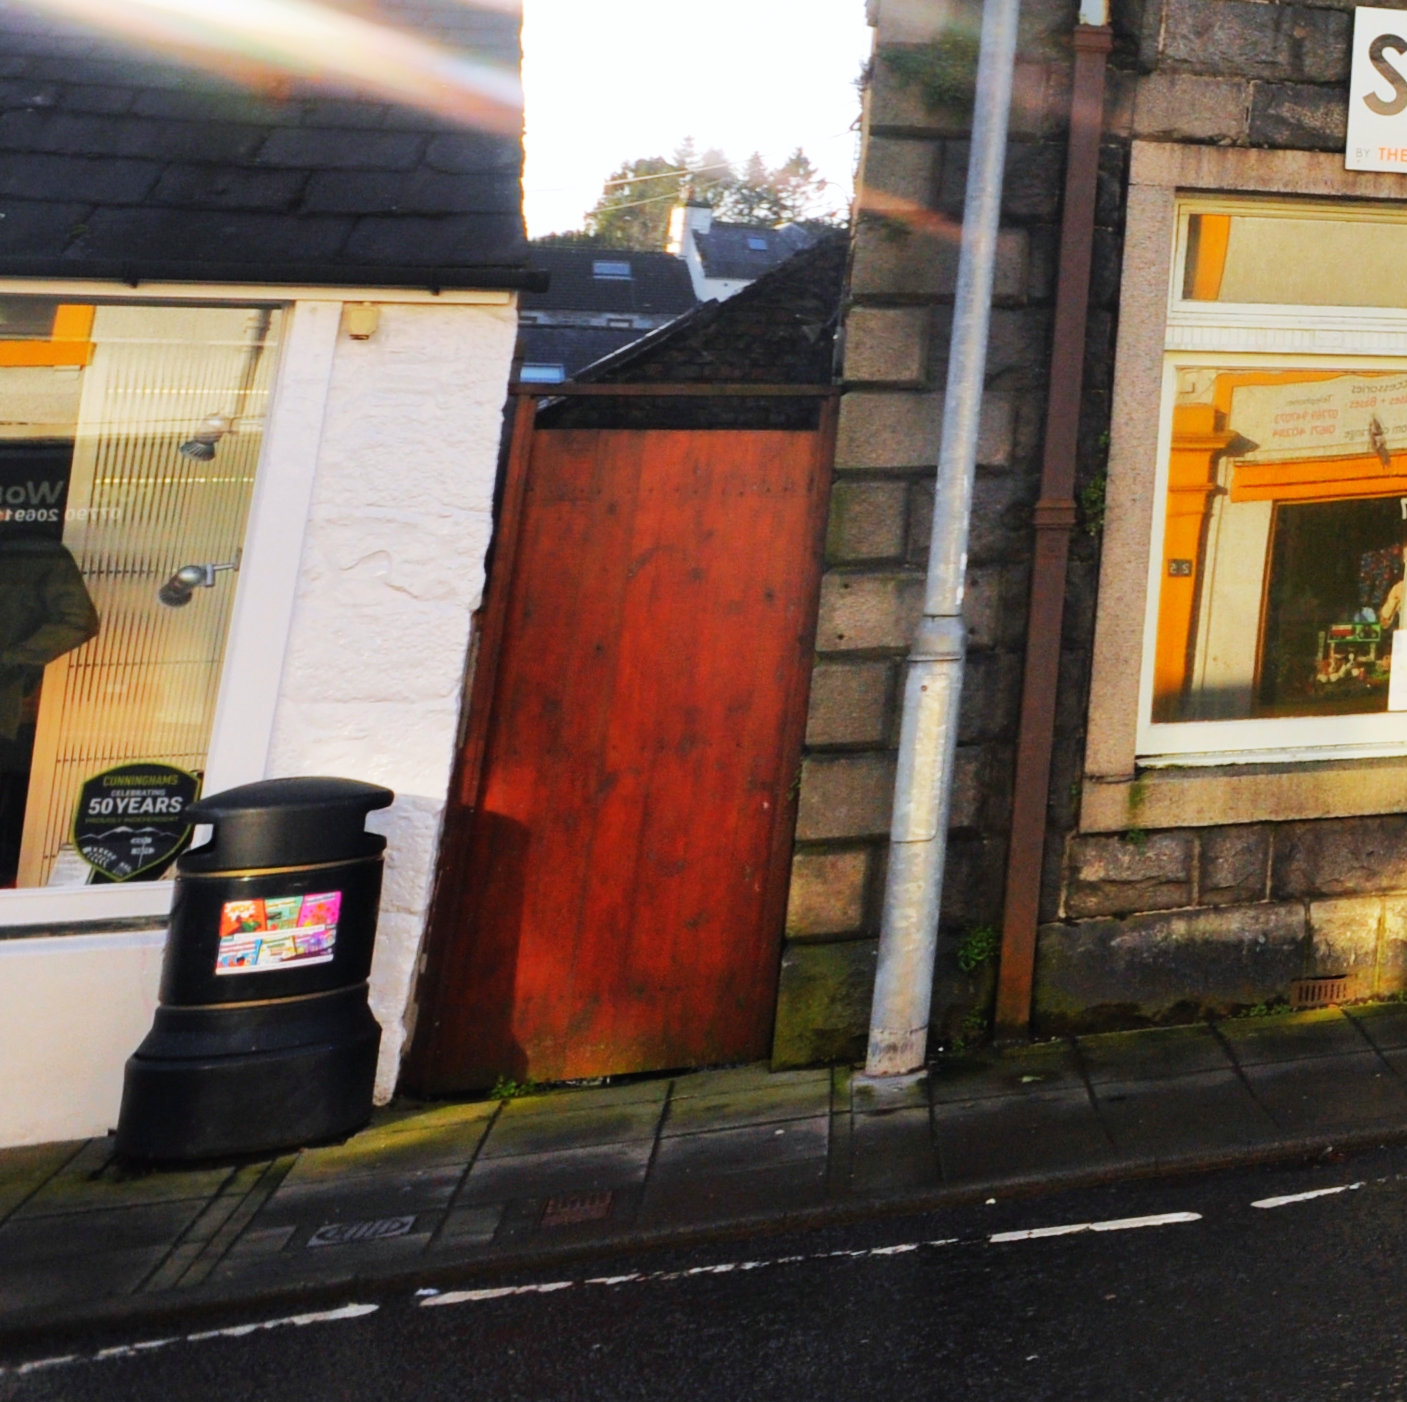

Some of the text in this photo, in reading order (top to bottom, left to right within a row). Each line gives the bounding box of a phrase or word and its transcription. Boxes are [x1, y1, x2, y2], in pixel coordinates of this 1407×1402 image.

[1355, 148, 1370, 159] BY
[111, 789, 166, 798] CELEBRATING
[88, 796, 183, 815] 50 YEARS
